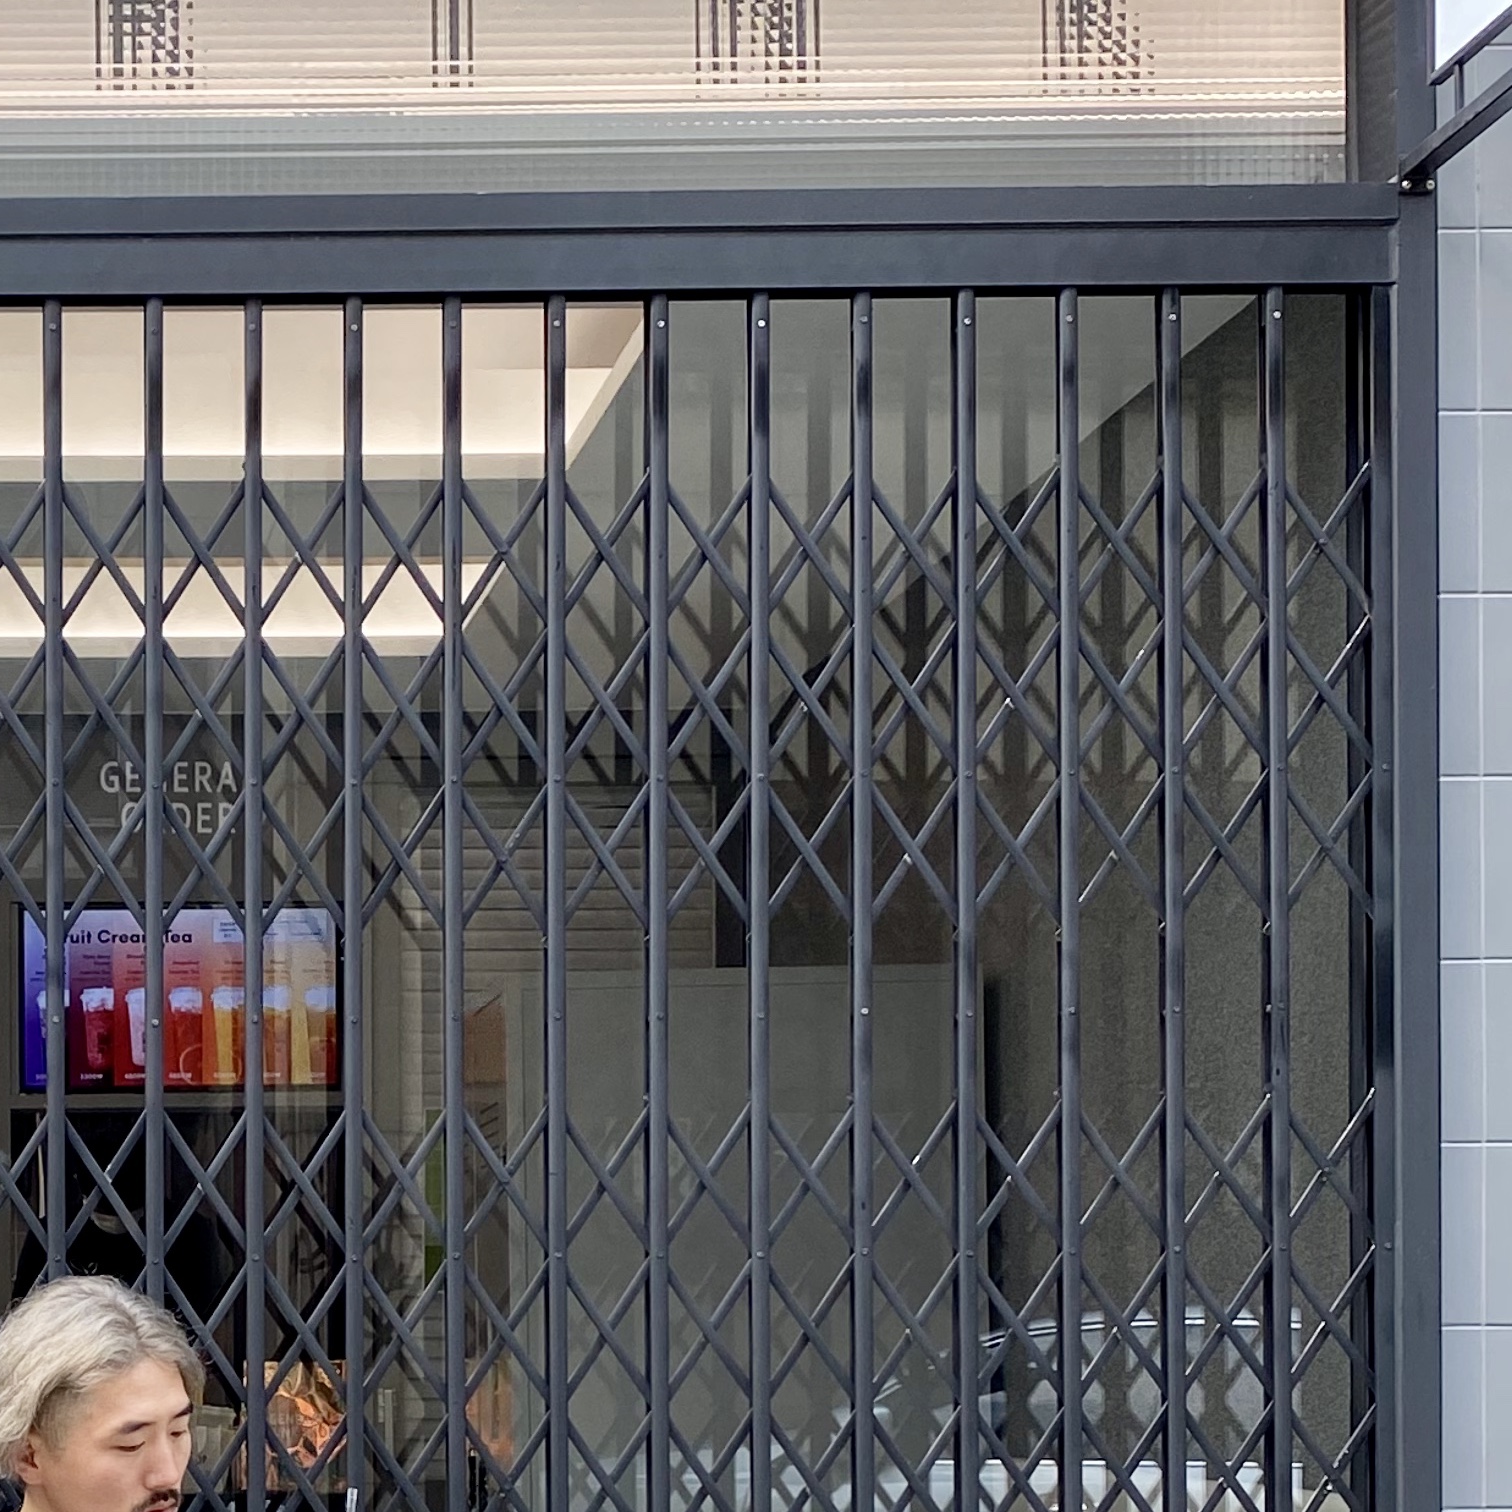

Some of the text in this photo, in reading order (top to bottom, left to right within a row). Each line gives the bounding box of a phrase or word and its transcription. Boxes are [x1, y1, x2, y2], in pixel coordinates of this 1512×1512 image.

[99, 760, 240, 793] GEERA
[61, 929, 92, 944] ruit
[97, 929, 147, 944] Crea
